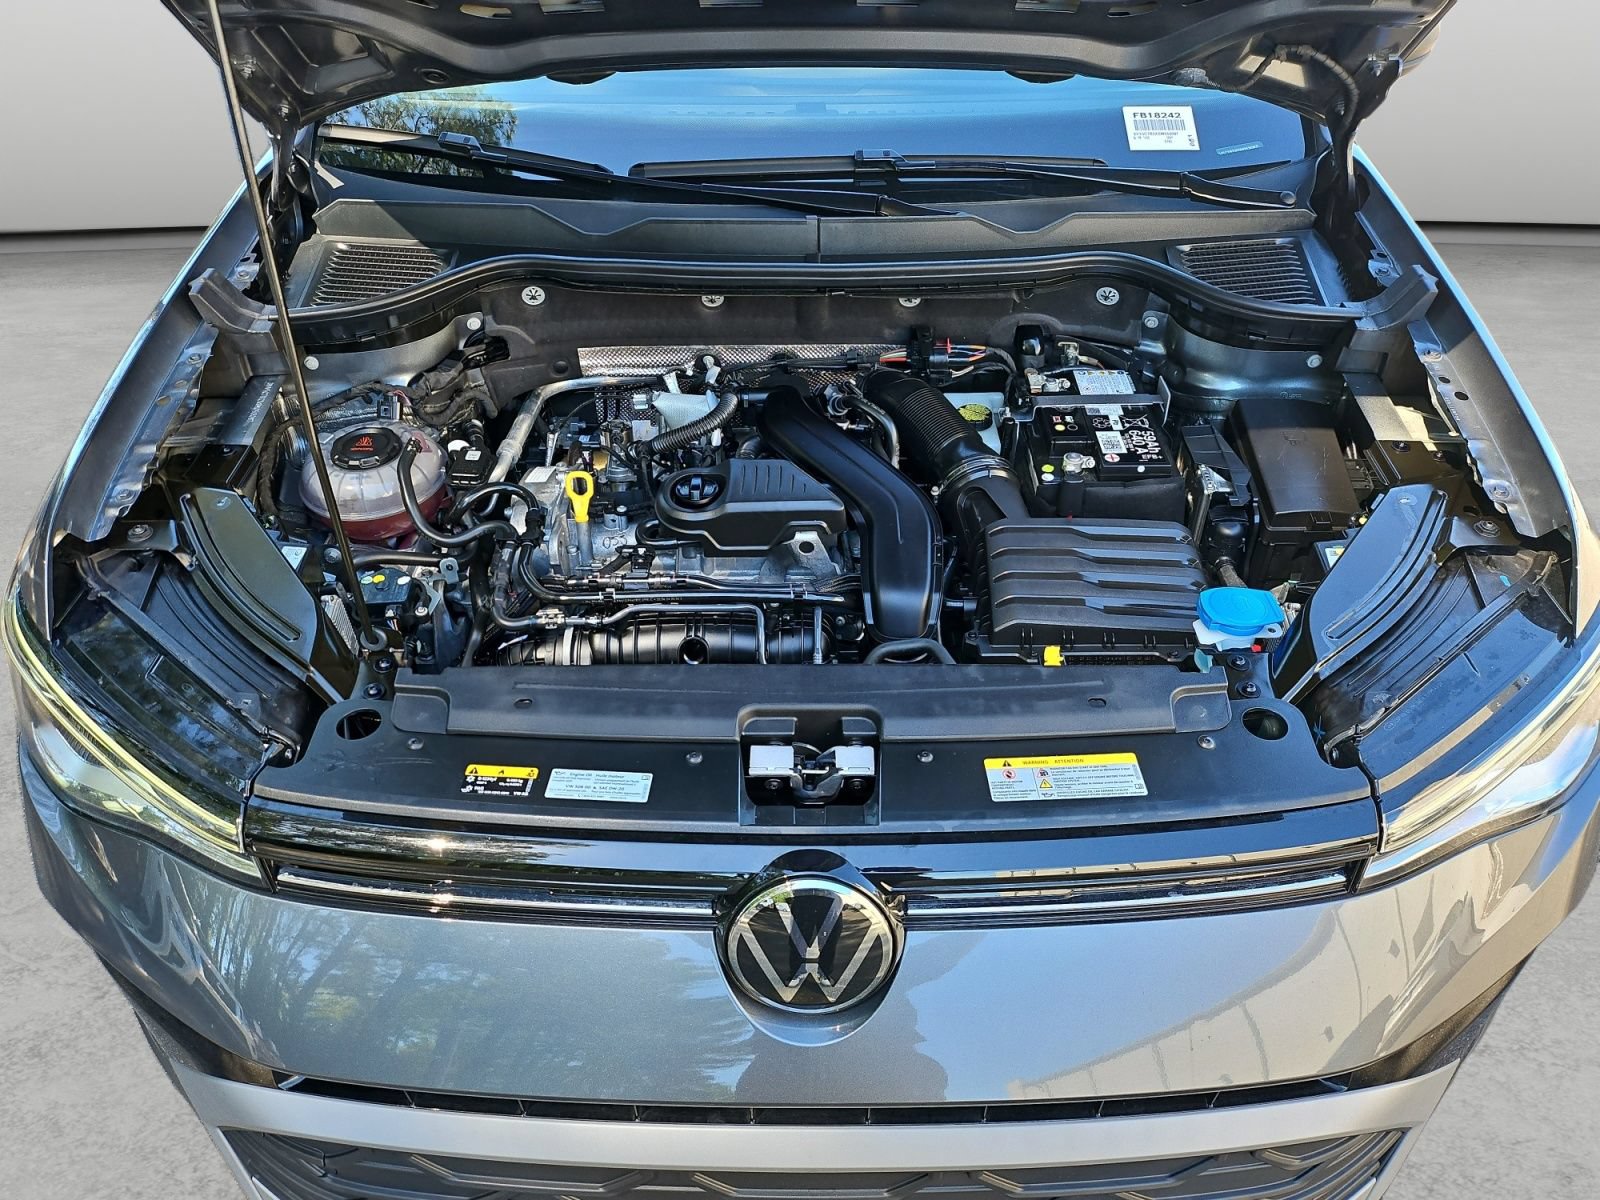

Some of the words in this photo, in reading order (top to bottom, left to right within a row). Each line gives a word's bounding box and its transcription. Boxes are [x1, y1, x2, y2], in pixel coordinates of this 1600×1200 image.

[1128, 430, 1146, 446] 640
[1141, 430, 1161, 453] 59Ah
[1134, 446, 1149, 455] A
